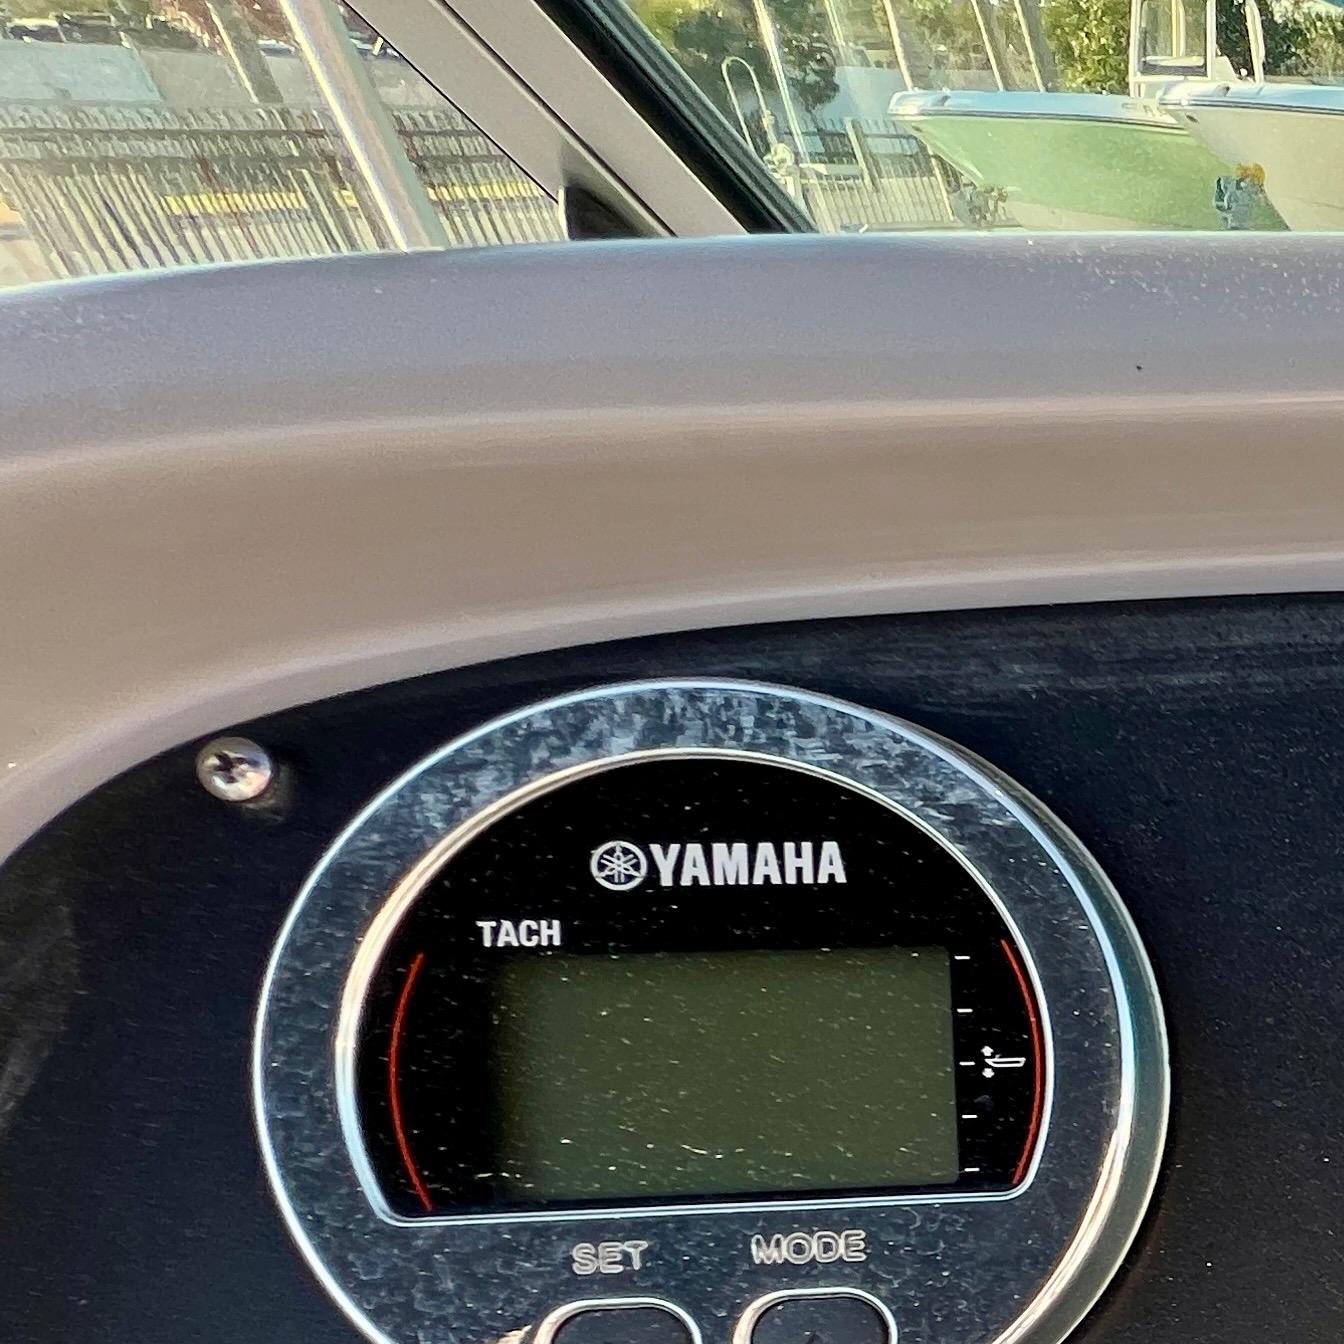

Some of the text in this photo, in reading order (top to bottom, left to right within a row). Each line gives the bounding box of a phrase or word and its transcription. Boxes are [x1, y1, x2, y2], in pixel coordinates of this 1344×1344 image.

[650, 841, 847, 887] YAMAHA
[476, 919, 561, 948] TACH
[571, 1240, 648, 1275] SET
[750, 1229, 867, 1264] MODE
